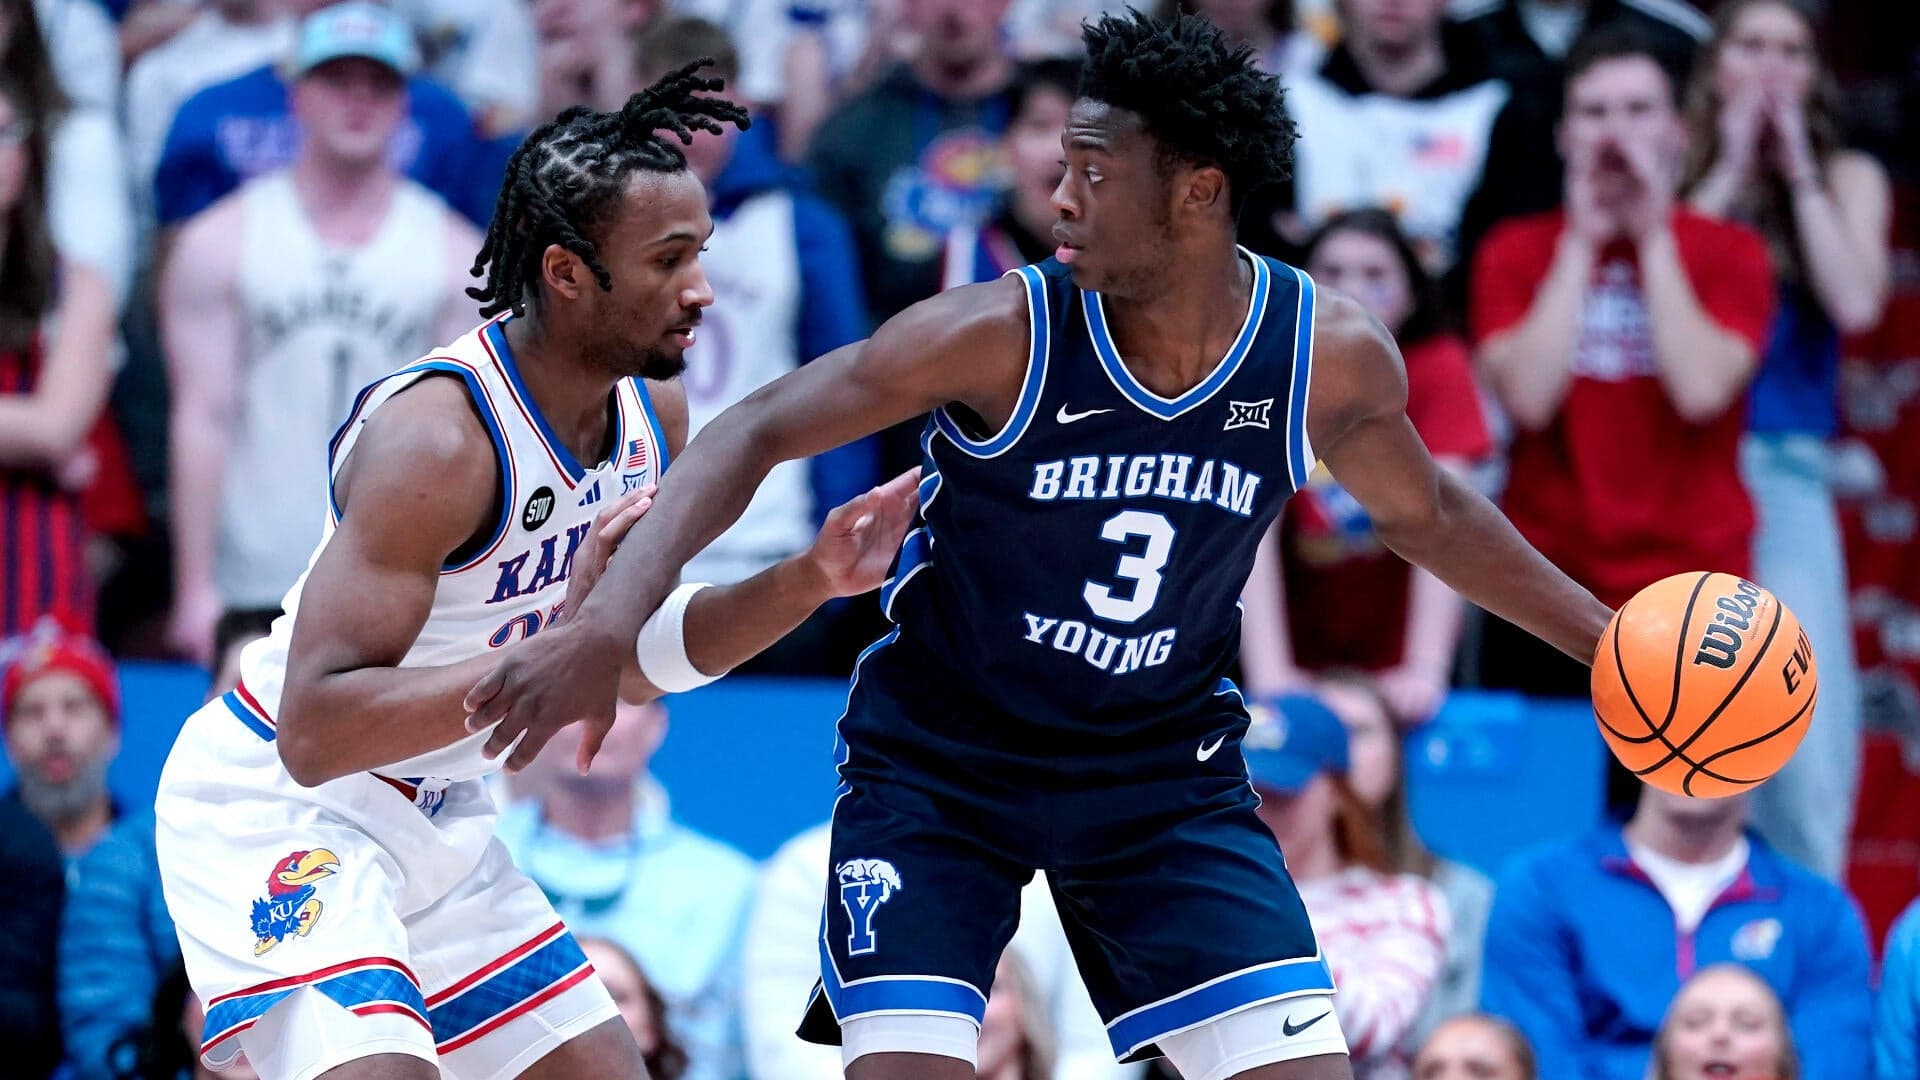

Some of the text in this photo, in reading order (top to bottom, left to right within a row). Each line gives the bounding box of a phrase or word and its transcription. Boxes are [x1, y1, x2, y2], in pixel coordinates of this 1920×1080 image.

[1223, 398, 1274, 431] XII
[526, 496, 552, 523] SW
[1030, 453, 1261, 516] BRIGHAM
[1083, 510, 1177, 623] 3
[1023, 611, 1177, 675] YOUNG
[1693, 579, 1761, 669] Wilso
[269, 900, 294, 923] KU
